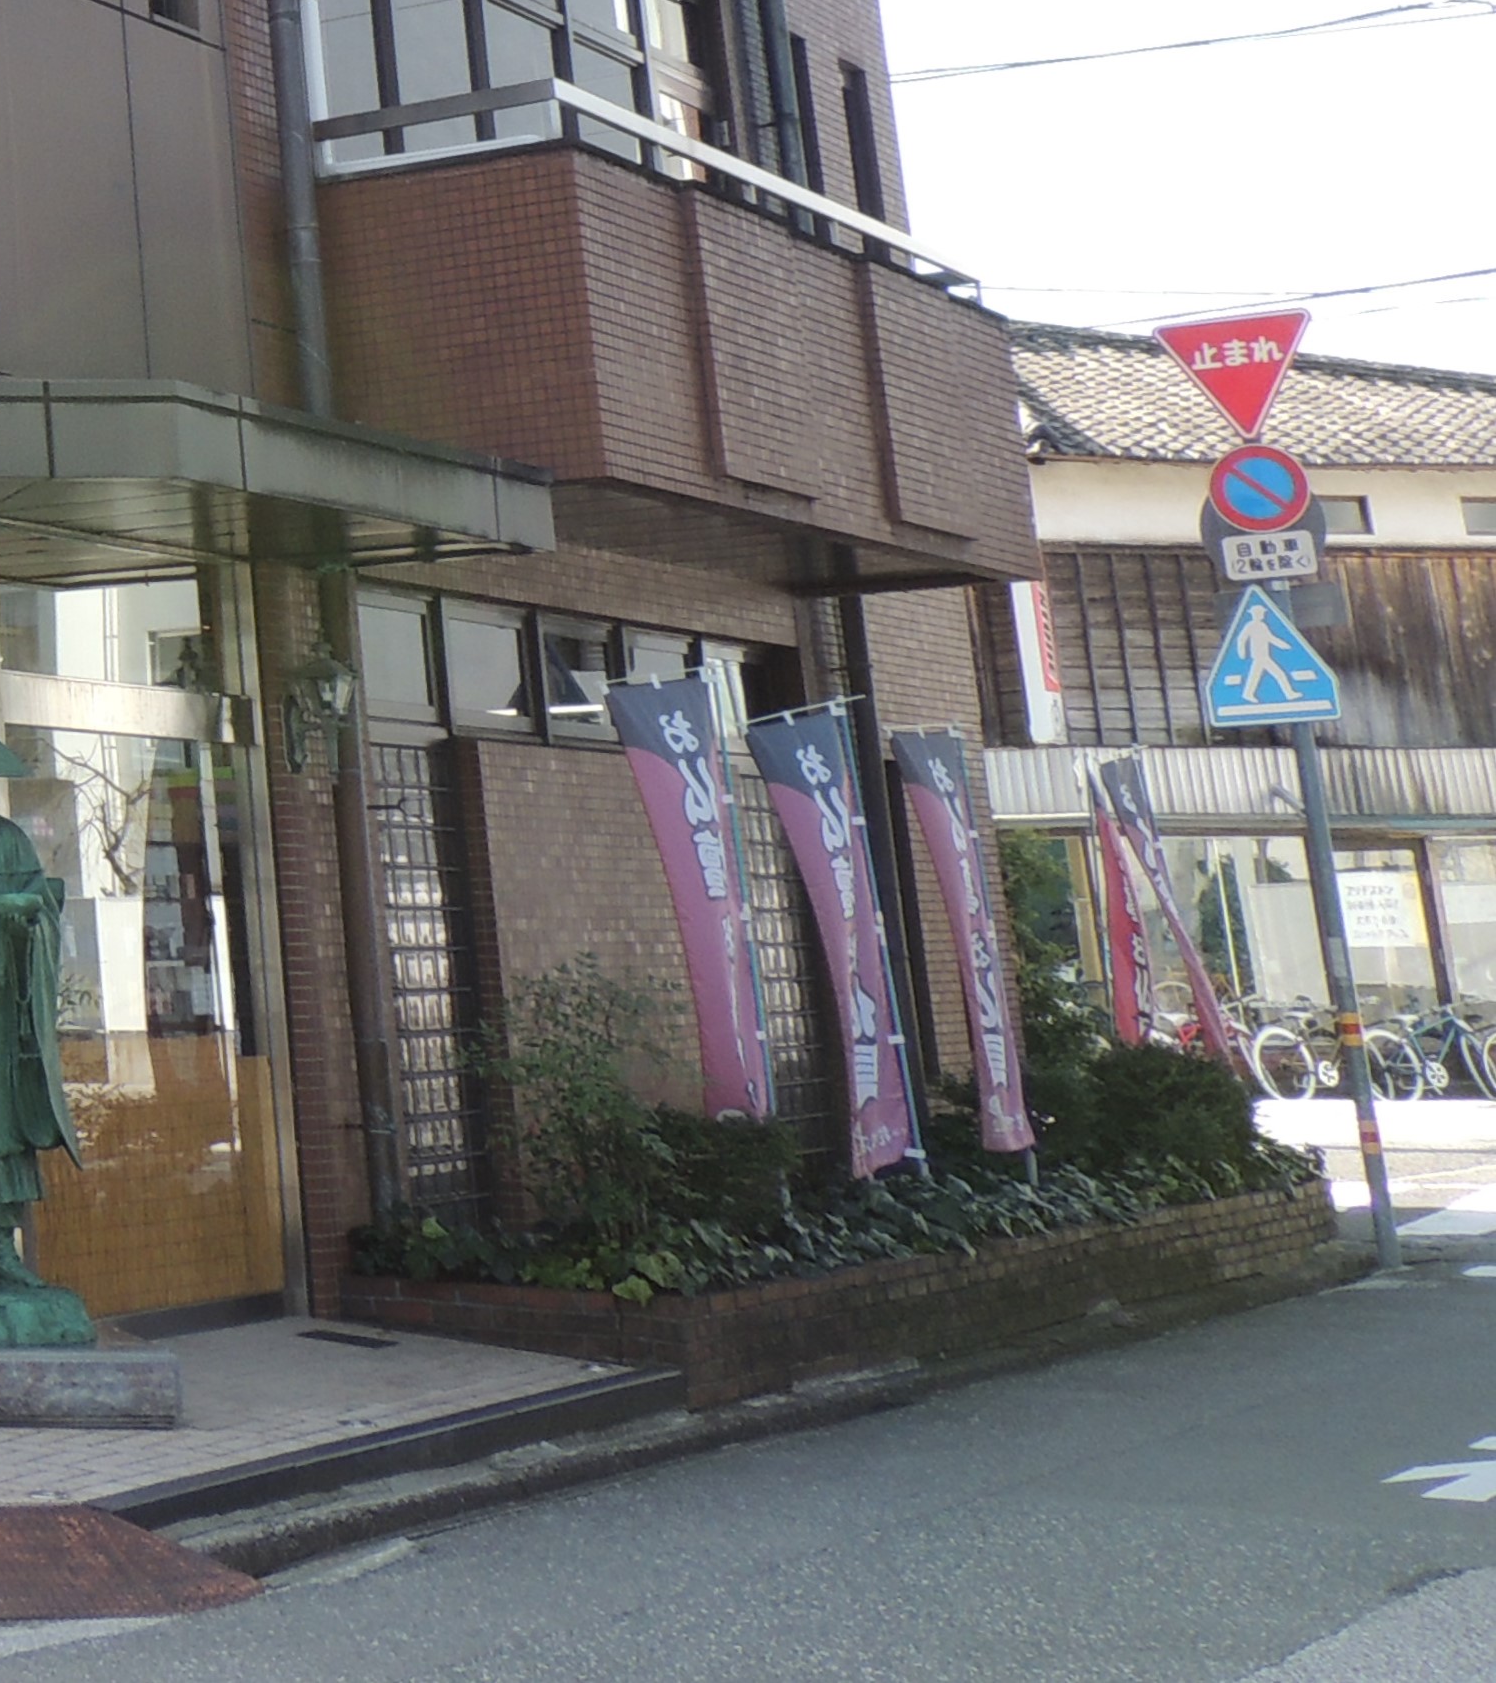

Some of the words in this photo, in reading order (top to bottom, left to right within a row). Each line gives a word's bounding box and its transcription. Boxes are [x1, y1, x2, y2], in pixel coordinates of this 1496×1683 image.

[1191, 336, 1284, 371] 止まれ
[1236, 538, 1299, 558] 自動車
